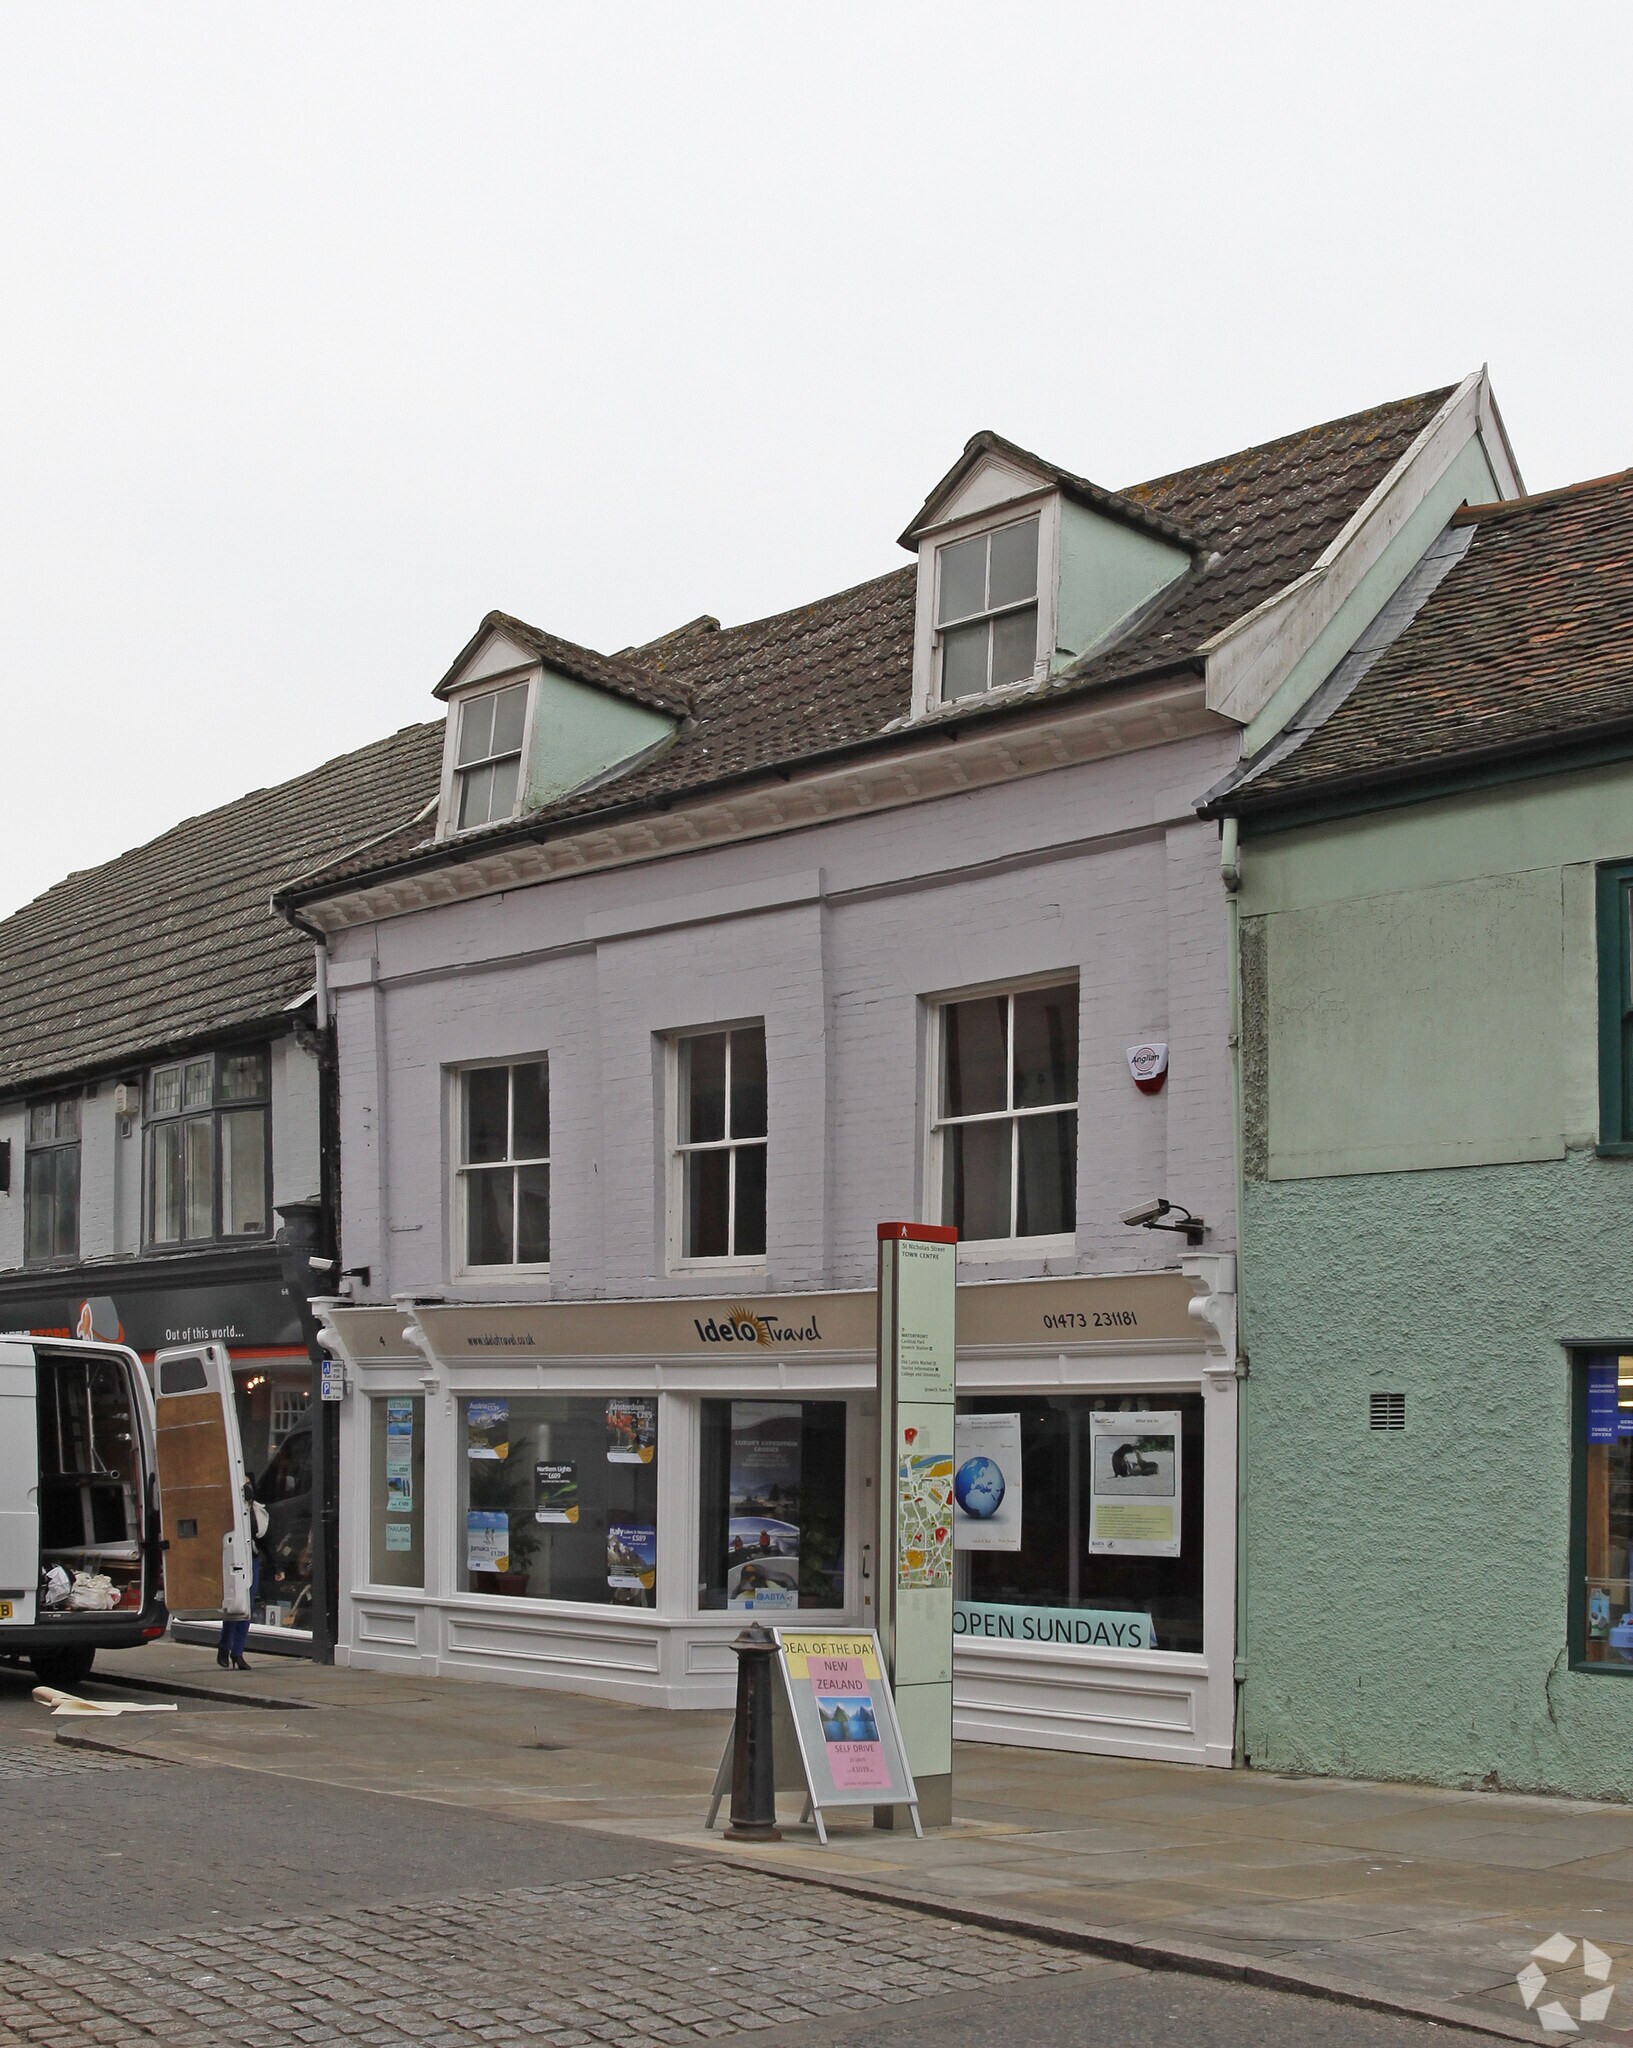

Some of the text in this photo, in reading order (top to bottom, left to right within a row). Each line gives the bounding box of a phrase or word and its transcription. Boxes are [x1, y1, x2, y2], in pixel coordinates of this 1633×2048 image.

[1131, 1054, 1160, 1065] Anglian
[909, 1243, 930, 1251] Nicholas
[919, 1252, 939, 1260] CENTRE
[1043, 1311, 1138, 1329] 01473 231181
[165, 1325, 244, 1342] Out of this world...
[694, 1315, 822, 1342] Idelo Travel
[380, 1336, 386, 1346] 4
[557, 1466, 572, 1474] Lights
[610, 1527, 624, 1537] Italy
[764, 1593, 785, 1601] ABTA
[1, 1604, 9, 1616] B
[953, 1611, 1142, 1648] OPEN SUNDAYS
[783, 1642, 875, 1655] DEAL OF THE DAY
[824, 1661, 848, 1672] NEW
[817, 1679, 863, 1690] ZEALAND
[835, 1744, 875, 1753] SELF DRIVE
